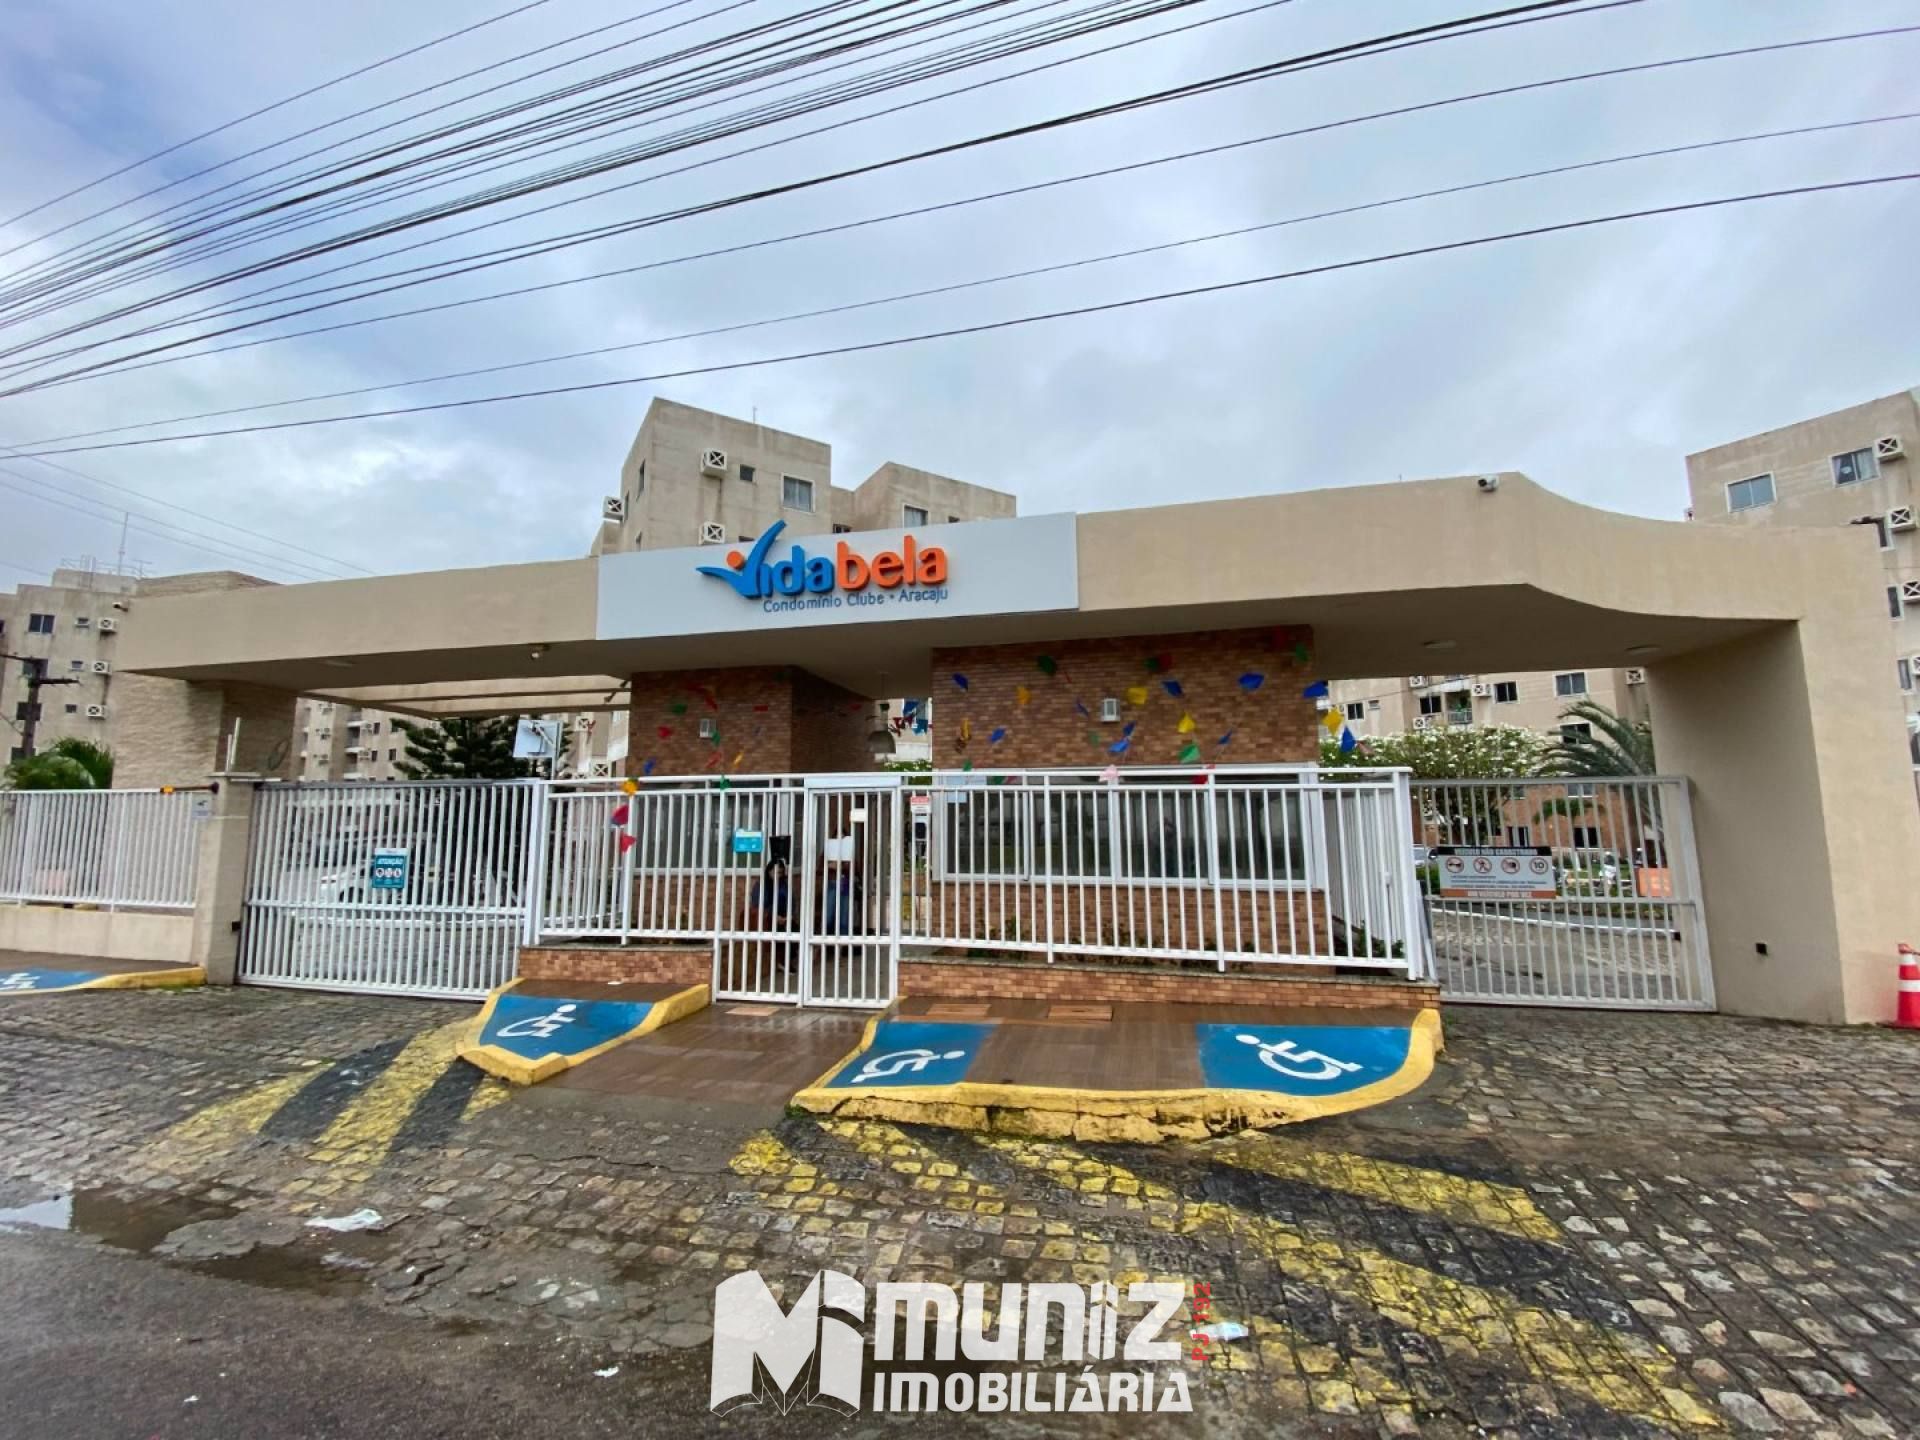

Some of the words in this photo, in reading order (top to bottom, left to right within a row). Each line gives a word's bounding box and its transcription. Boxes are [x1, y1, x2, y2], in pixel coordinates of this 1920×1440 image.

[694, 519, 948, 599] Vidabela
[846, 588, 884, 606] Clube
[898, 586, 948, 604] Aracaju
